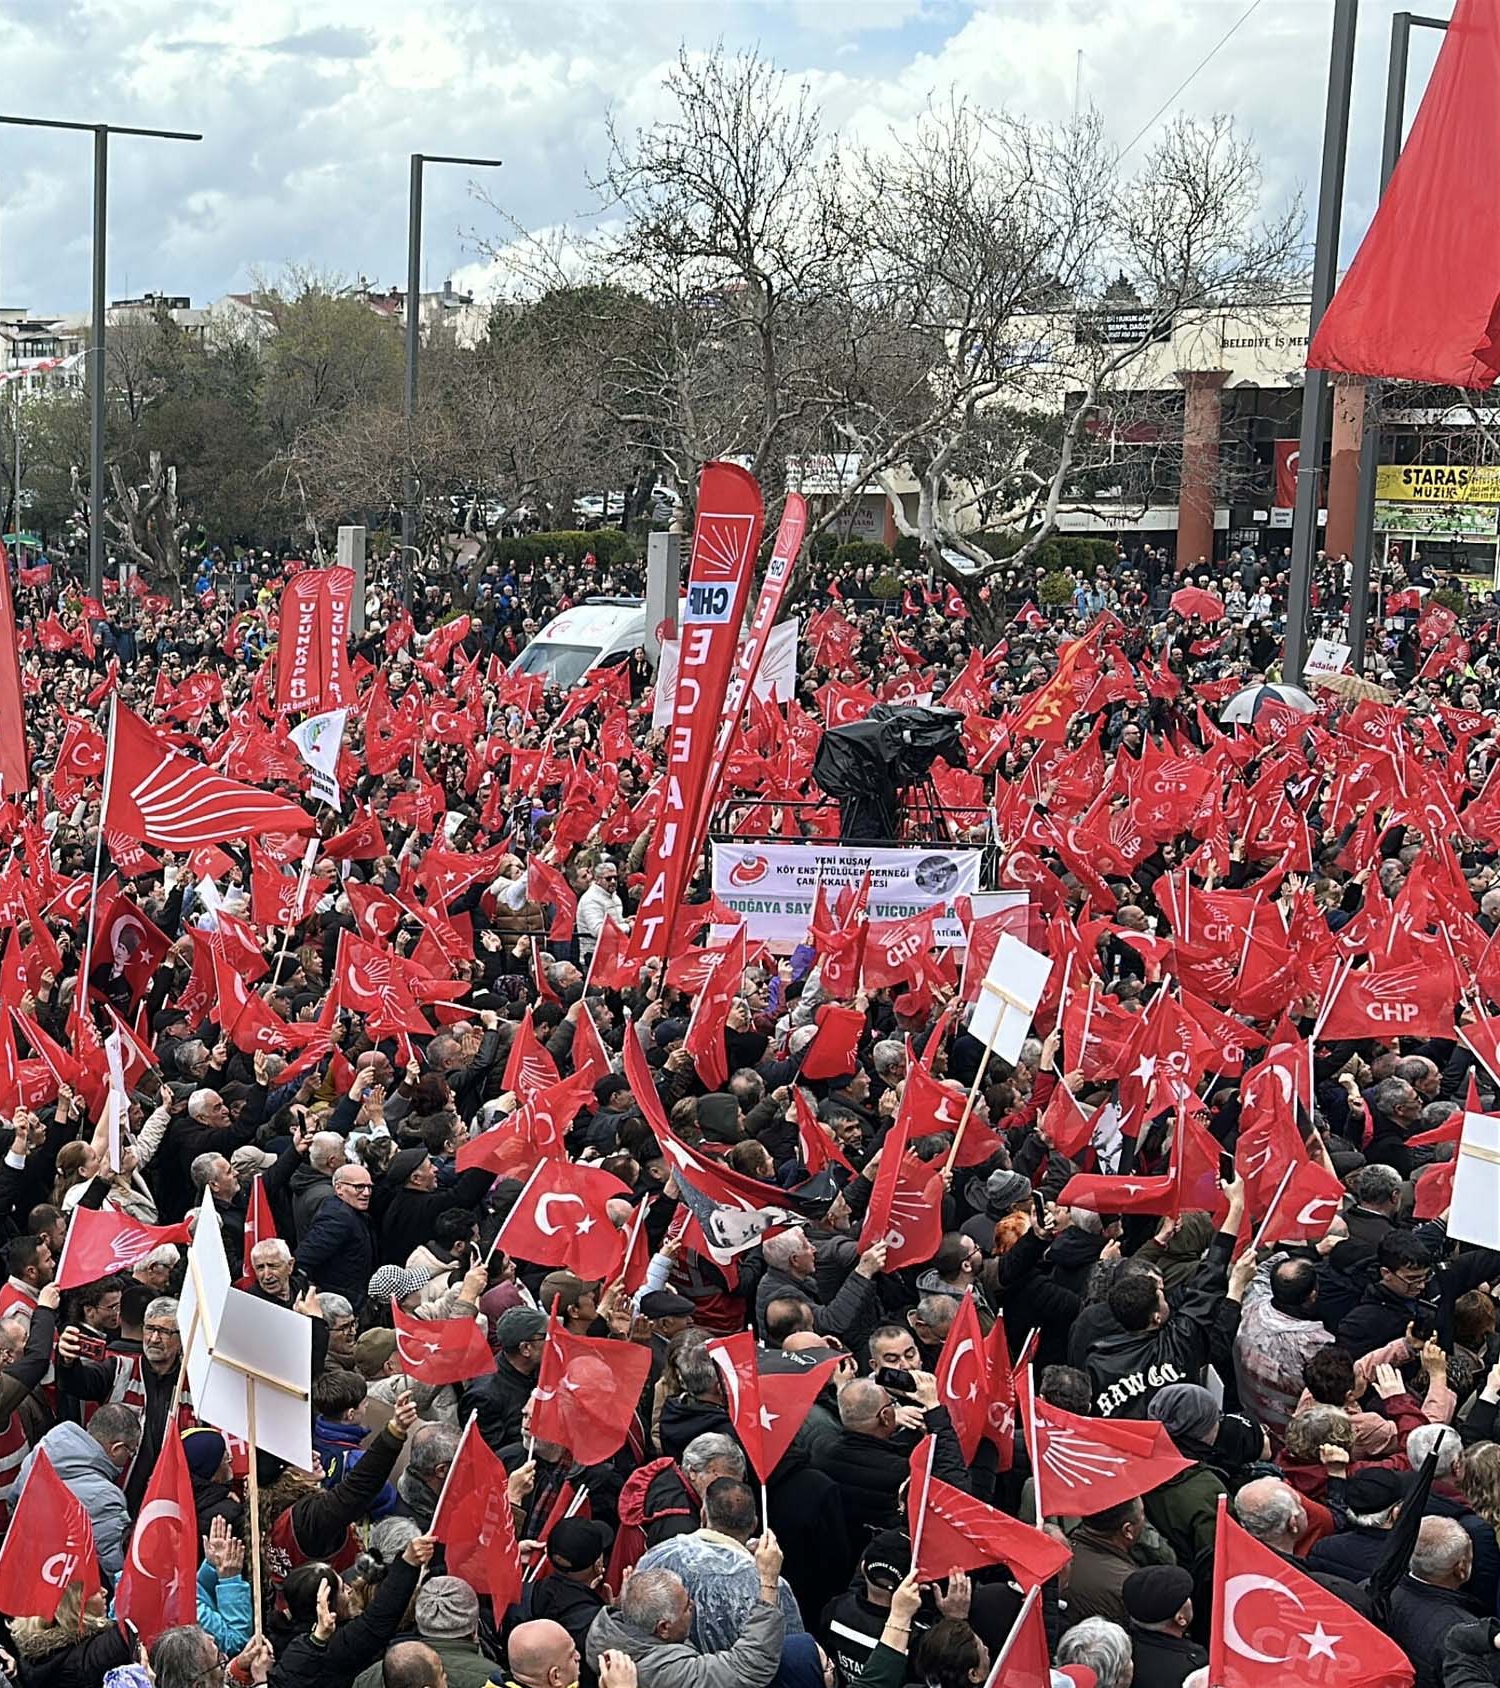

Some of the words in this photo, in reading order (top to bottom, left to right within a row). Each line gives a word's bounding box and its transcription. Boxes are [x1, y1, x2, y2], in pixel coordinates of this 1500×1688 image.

[1309, 659, 1338, 673] adalet
[1457, 716, 1482, 733] CHP
[114, 847, 146, 867] CHP
[1120, 837, 1142, 859] CHP
[777, 865, 795, 875] KÖY
[815, 856, 837, 866] YENİ
[885, 933, 923, 968] CHP
[1365, 1002, 1419, 1023] CHP
